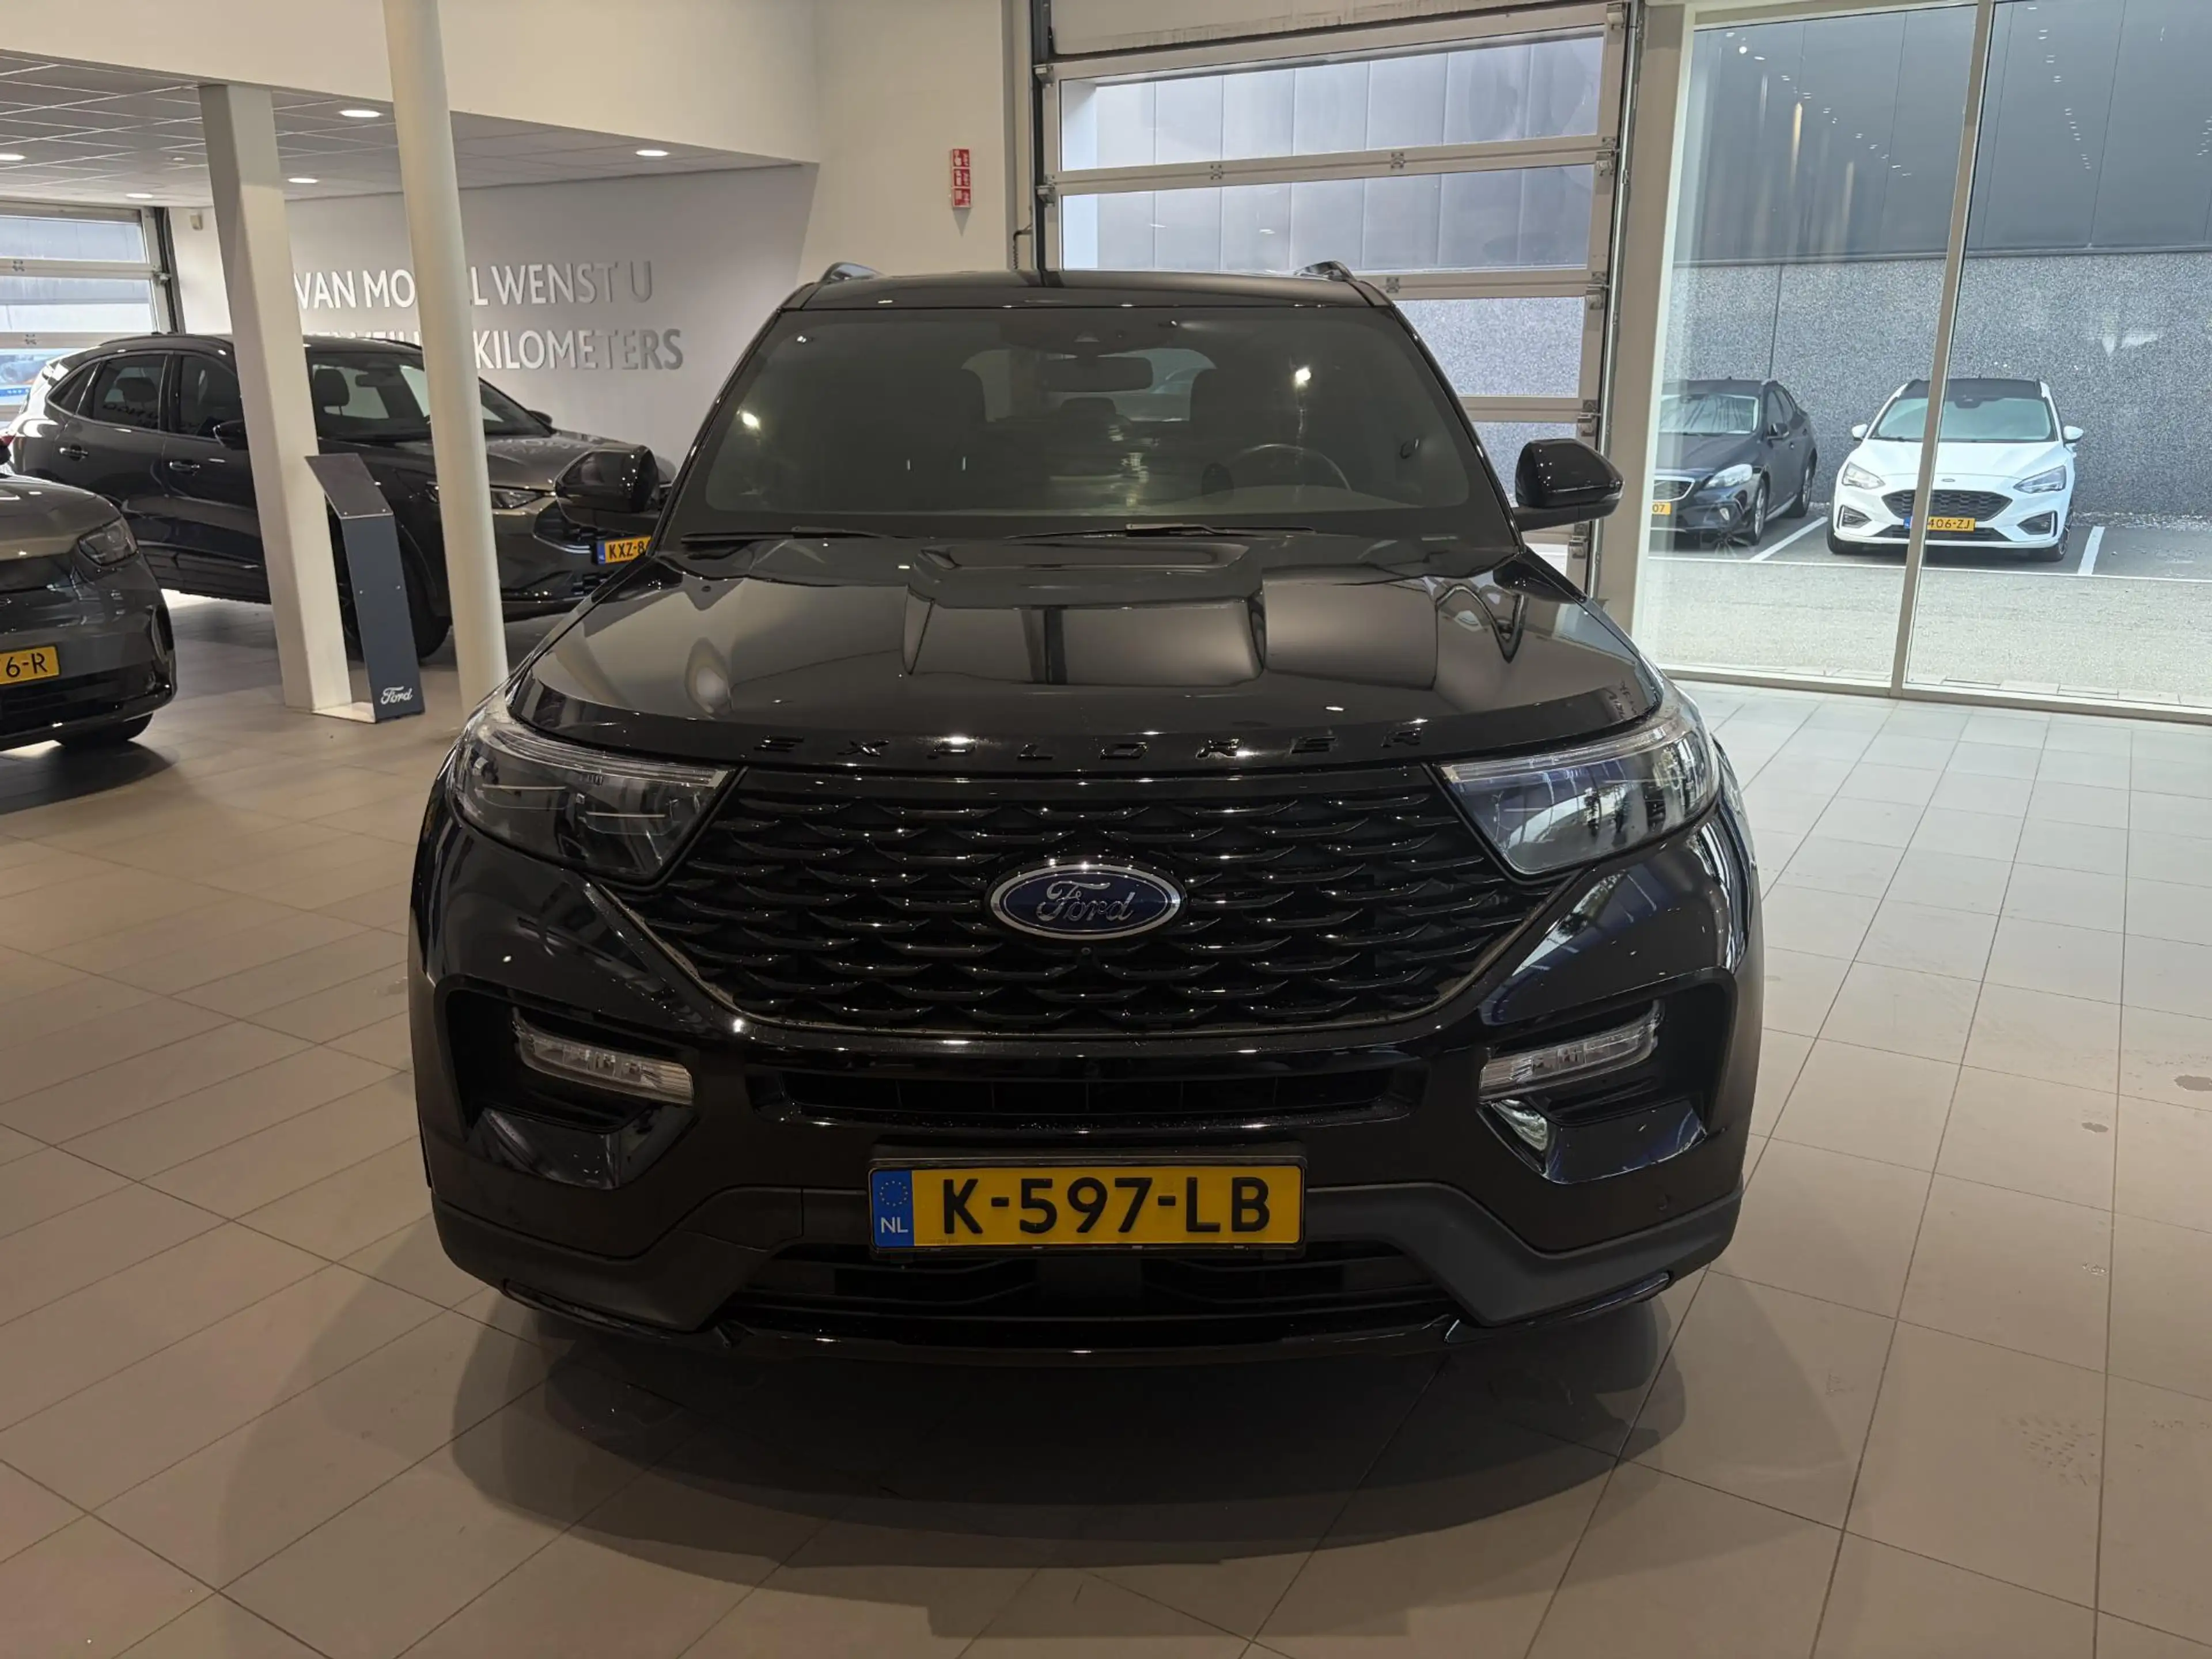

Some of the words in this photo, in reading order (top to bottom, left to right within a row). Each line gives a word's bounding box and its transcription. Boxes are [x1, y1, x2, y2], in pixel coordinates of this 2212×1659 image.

[294, 271, 357, 309] VAN
[491, 262, 618, 306] WENST
[630, 260, 653, 304] U
[472, 328, 684, 370] KILOMETERS
[381, 685, 413, 704] Ford
[1037, 881, 1136, 921] Ford
[880, 1217, 908, 1233] NL
[942, 1177, 1270, 1234] K-597-LB
